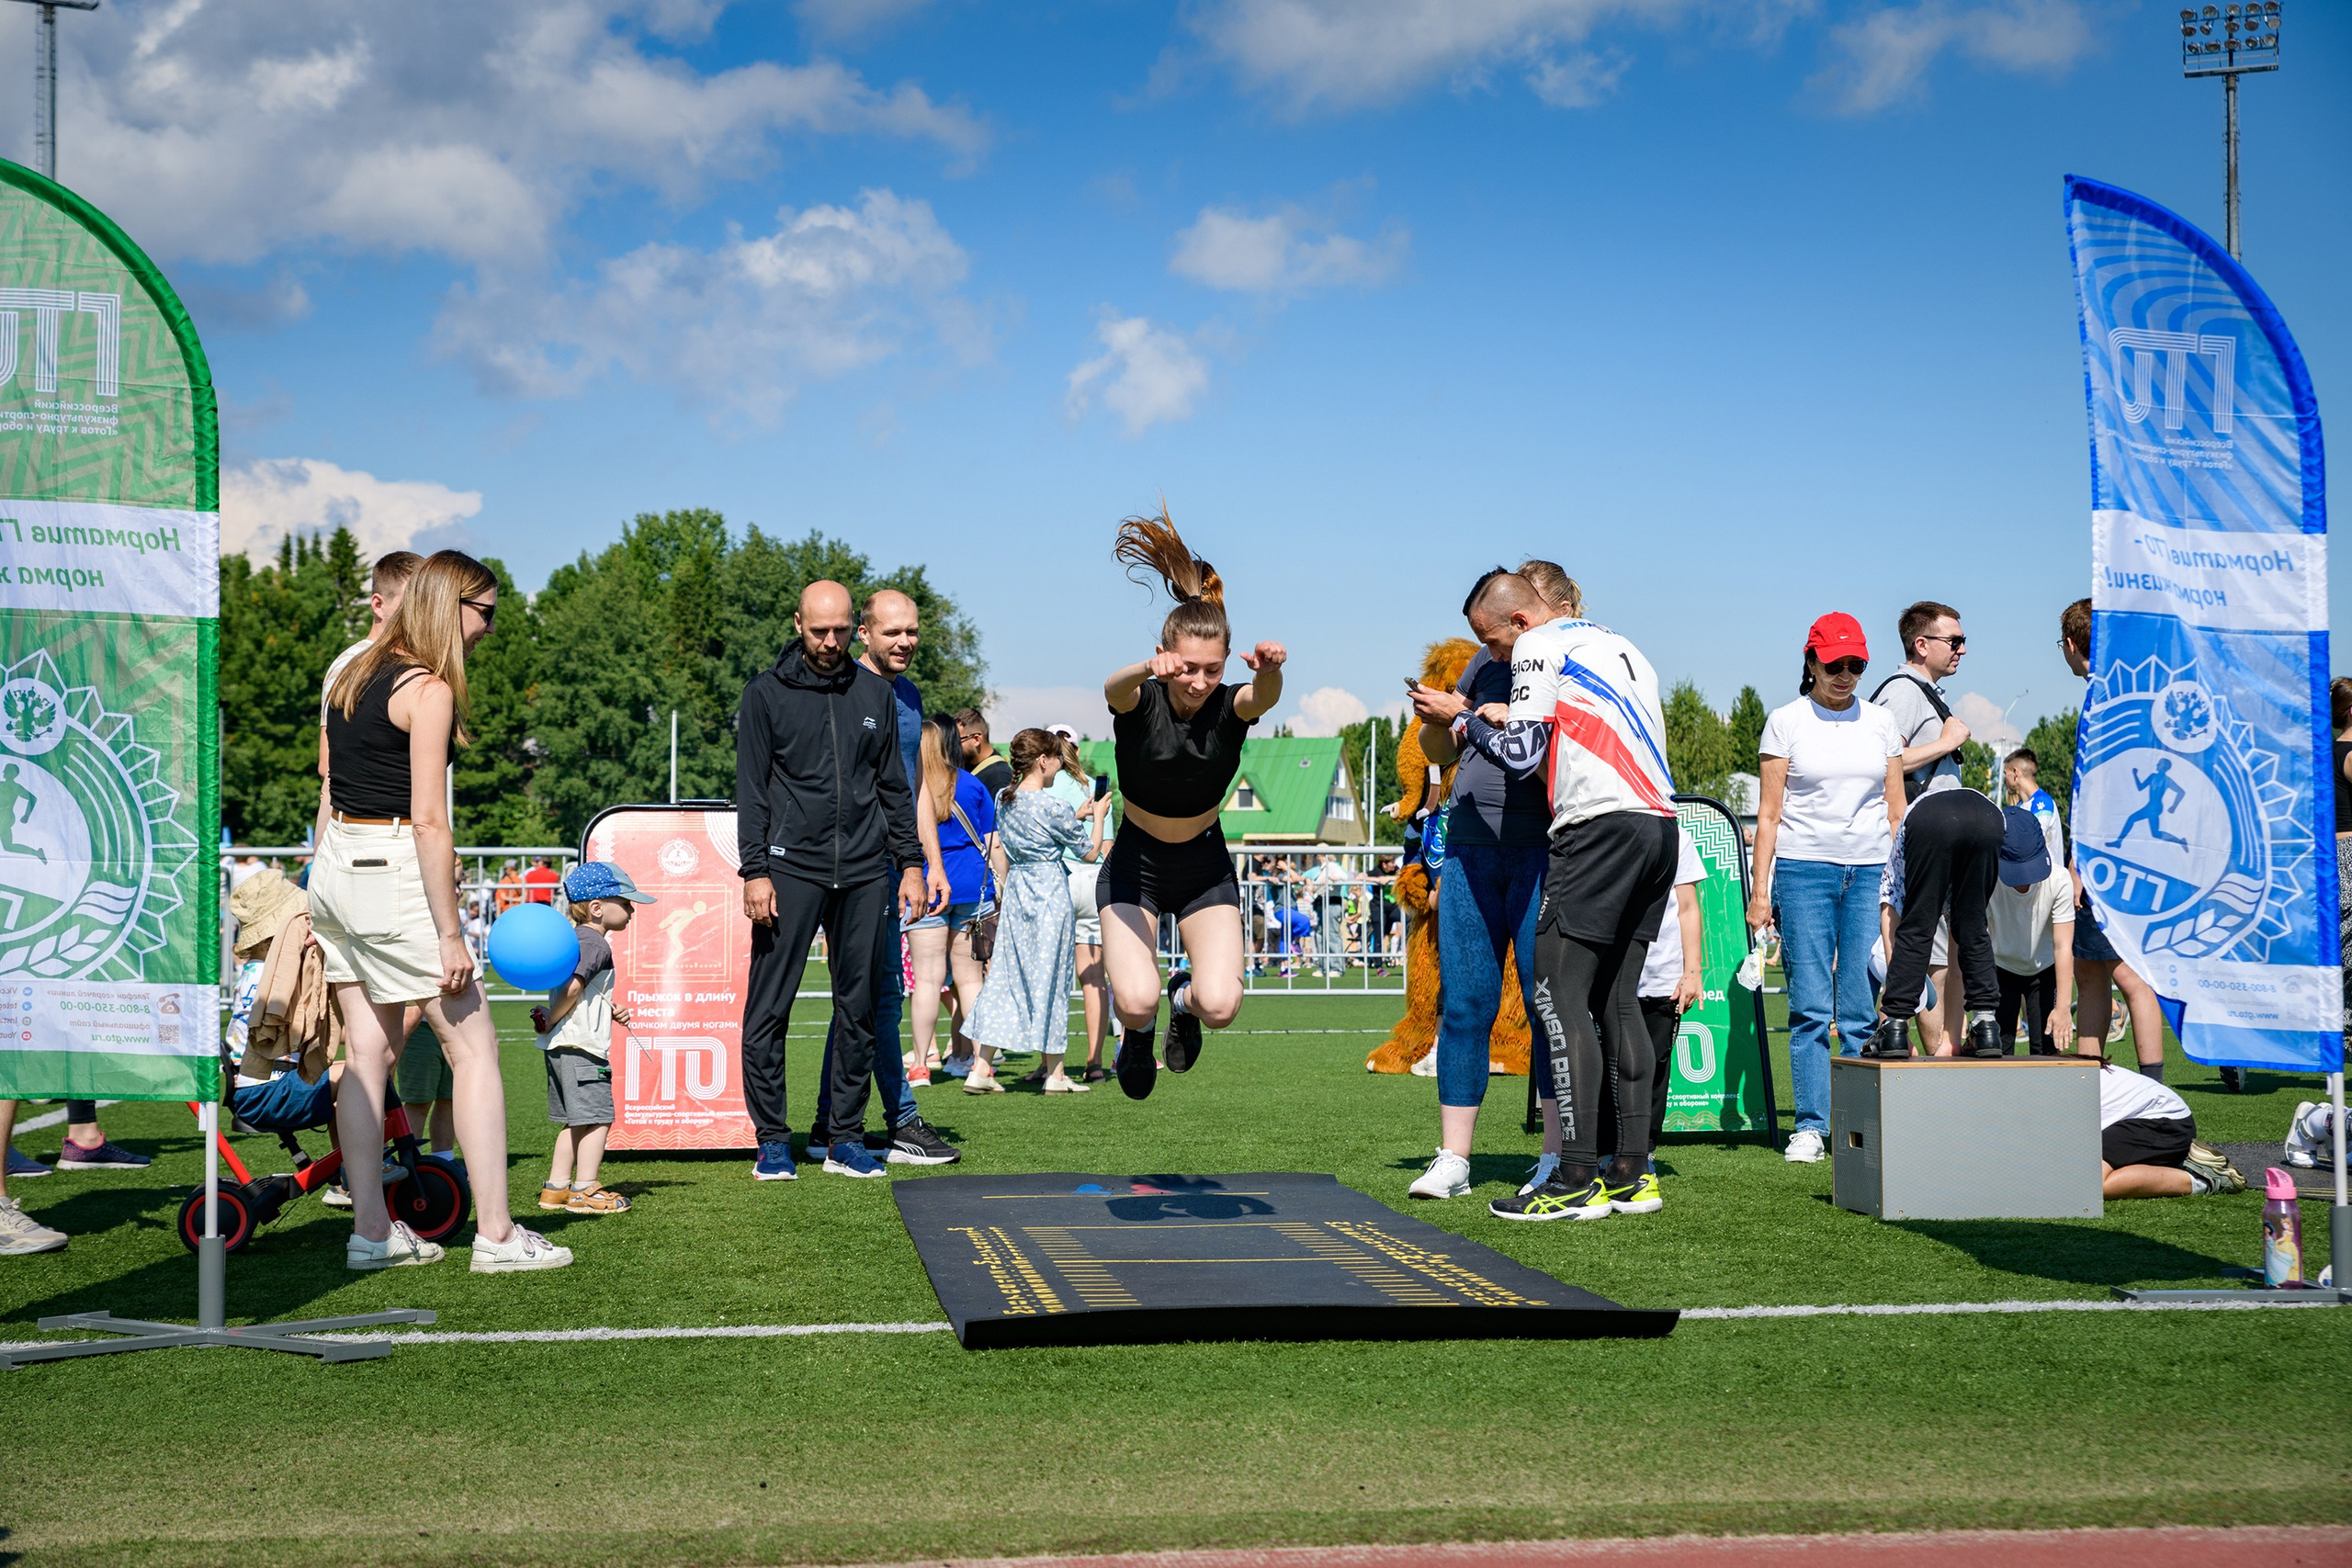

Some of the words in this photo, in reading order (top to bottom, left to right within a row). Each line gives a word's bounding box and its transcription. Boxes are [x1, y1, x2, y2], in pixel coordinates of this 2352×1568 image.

[1619, 652, 1636, 682] 1
[627, 990, 681, 1005] Прыжок
[684, 993, 693, 1001] в
[695, 992, 736, 1004] длину
[628, 1008, 634, 1017] с
[637, 1008, 675, 1017] места
[670, 1021, 700, 1031] двумя
[625, 1036, 727, 1101] ГТО
[1551, 1056, 1577, 1142] PRINCE
